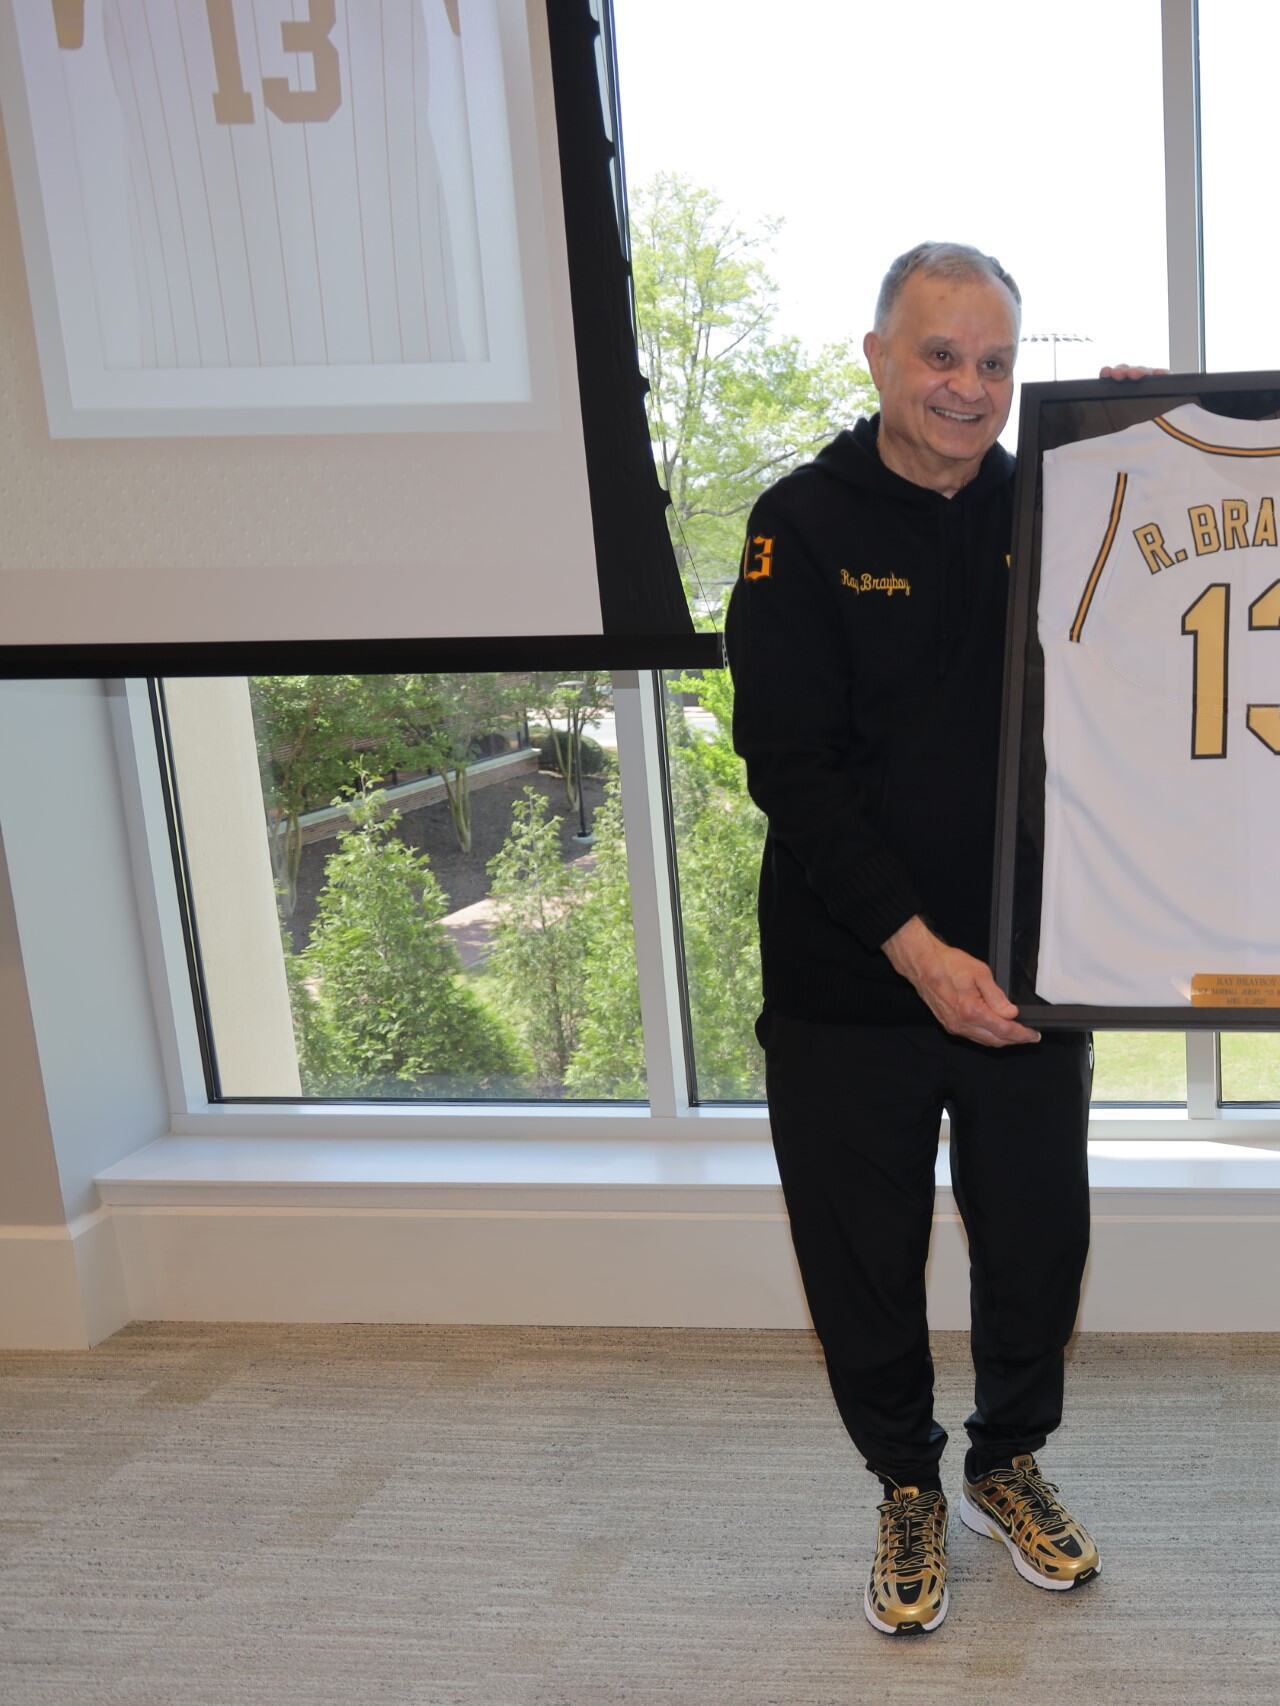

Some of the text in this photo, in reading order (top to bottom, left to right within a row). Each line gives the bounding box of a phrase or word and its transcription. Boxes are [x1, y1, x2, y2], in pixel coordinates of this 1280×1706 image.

[206, 0, 342, 124] 13
[743, 536, 773, 581] 3
[840, 568, 911, 597] Ray Brayboy
